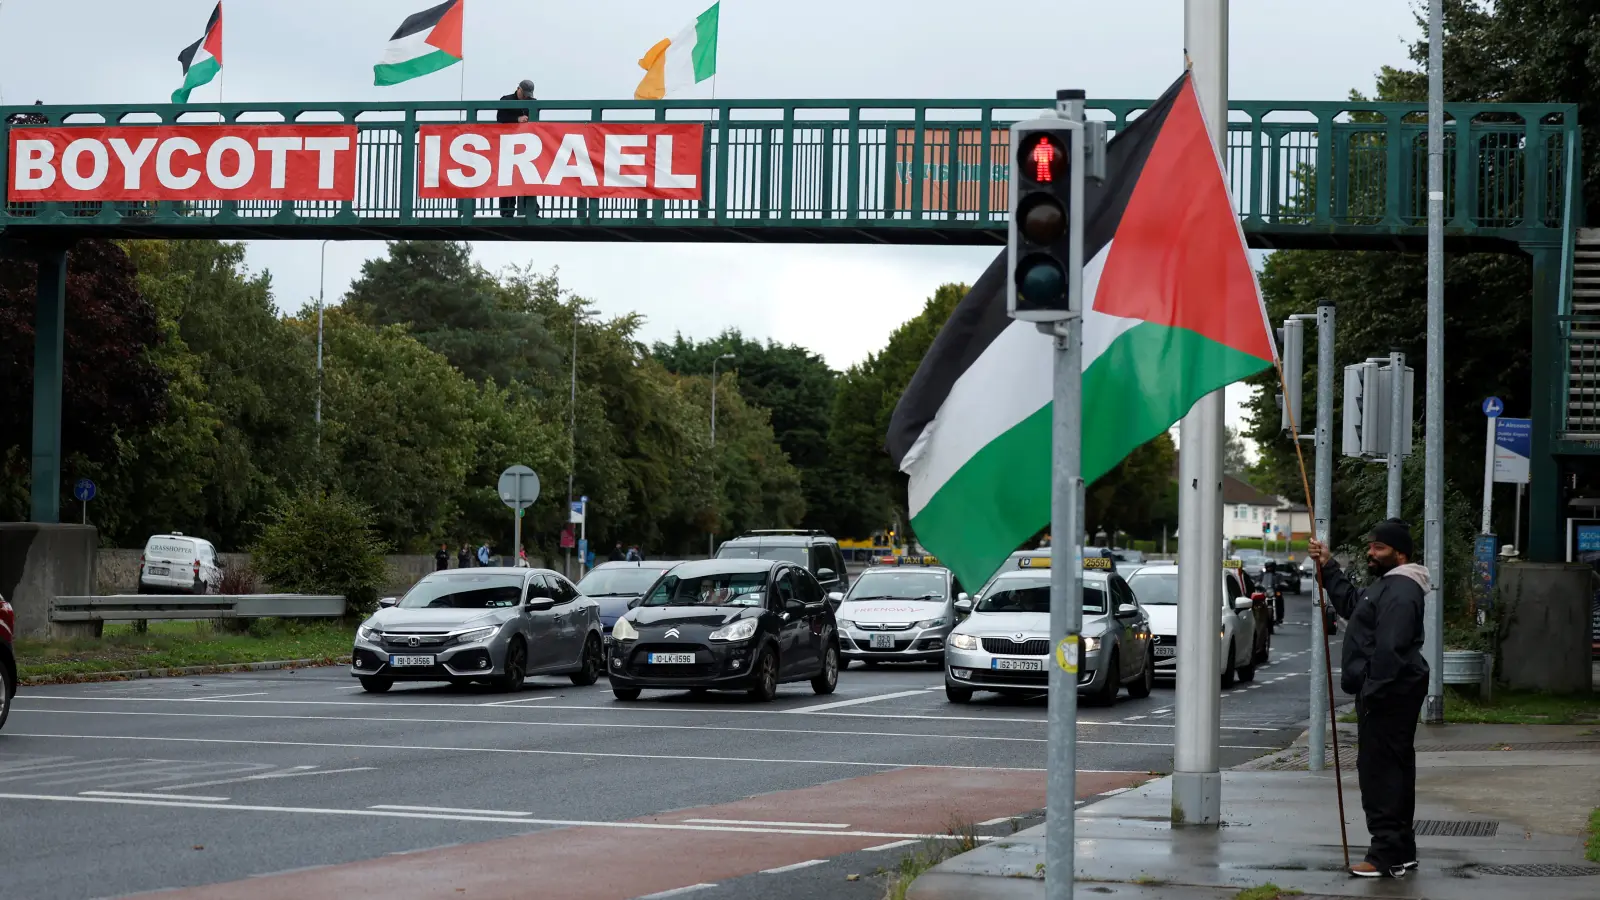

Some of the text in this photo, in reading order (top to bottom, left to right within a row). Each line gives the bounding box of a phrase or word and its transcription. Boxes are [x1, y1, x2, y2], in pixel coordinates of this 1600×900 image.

[14, 133, 697, 191] BOYCOTT ISRAEL
[150, 544, 193, 554] GRASSHOPPER
[902, 556, 921, 564] TAXI
[1086, 559, 1110, 568] 25597
[1000, 660, 1039, 670] 162-D-17379
